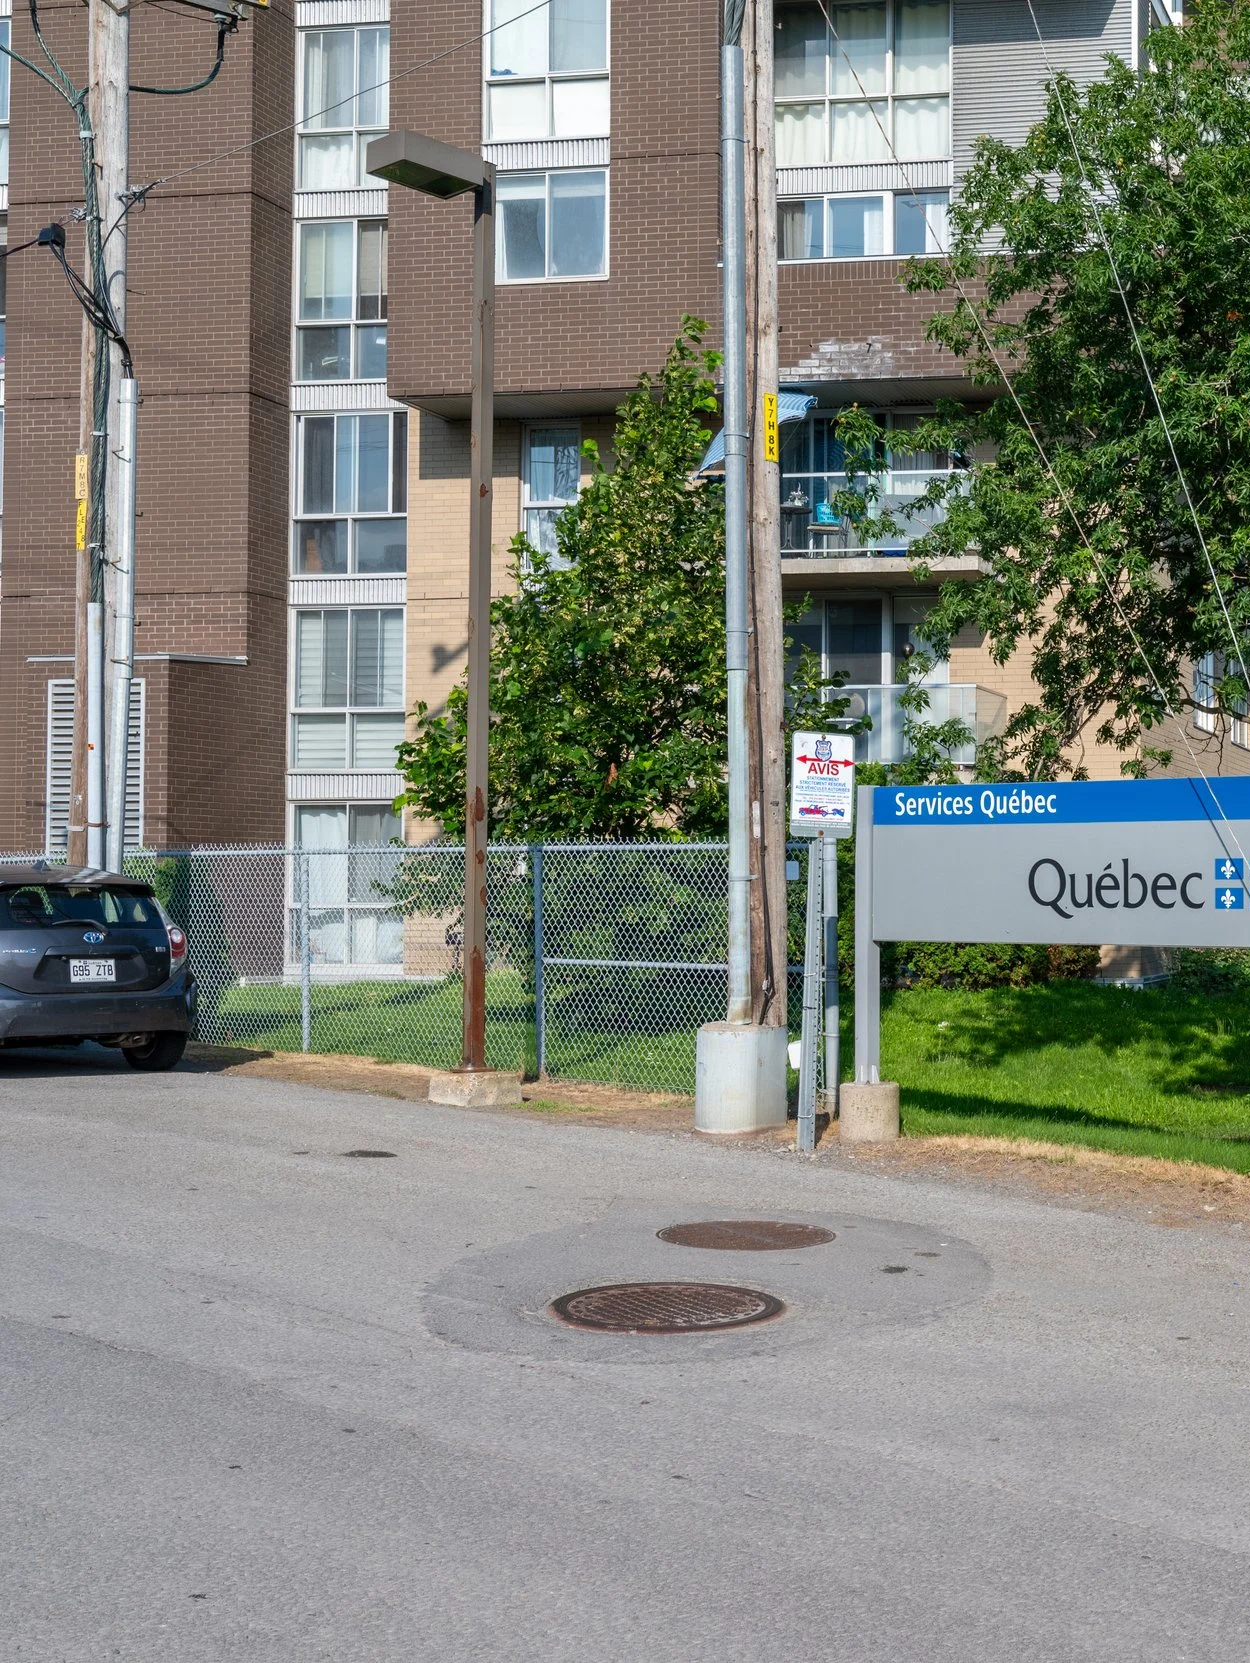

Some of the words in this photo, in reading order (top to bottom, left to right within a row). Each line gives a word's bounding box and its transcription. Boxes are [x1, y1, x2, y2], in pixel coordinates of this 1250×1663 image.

[808, 762, 840, 776] AVIS
[895, 792, 973, 816] Services
[980, 789, 1057, 818] Québec
[1028, 858, 1205, 919] Québec
[72, 964, 91, 977] G95
[96, 964, 114, 976] ZTB
